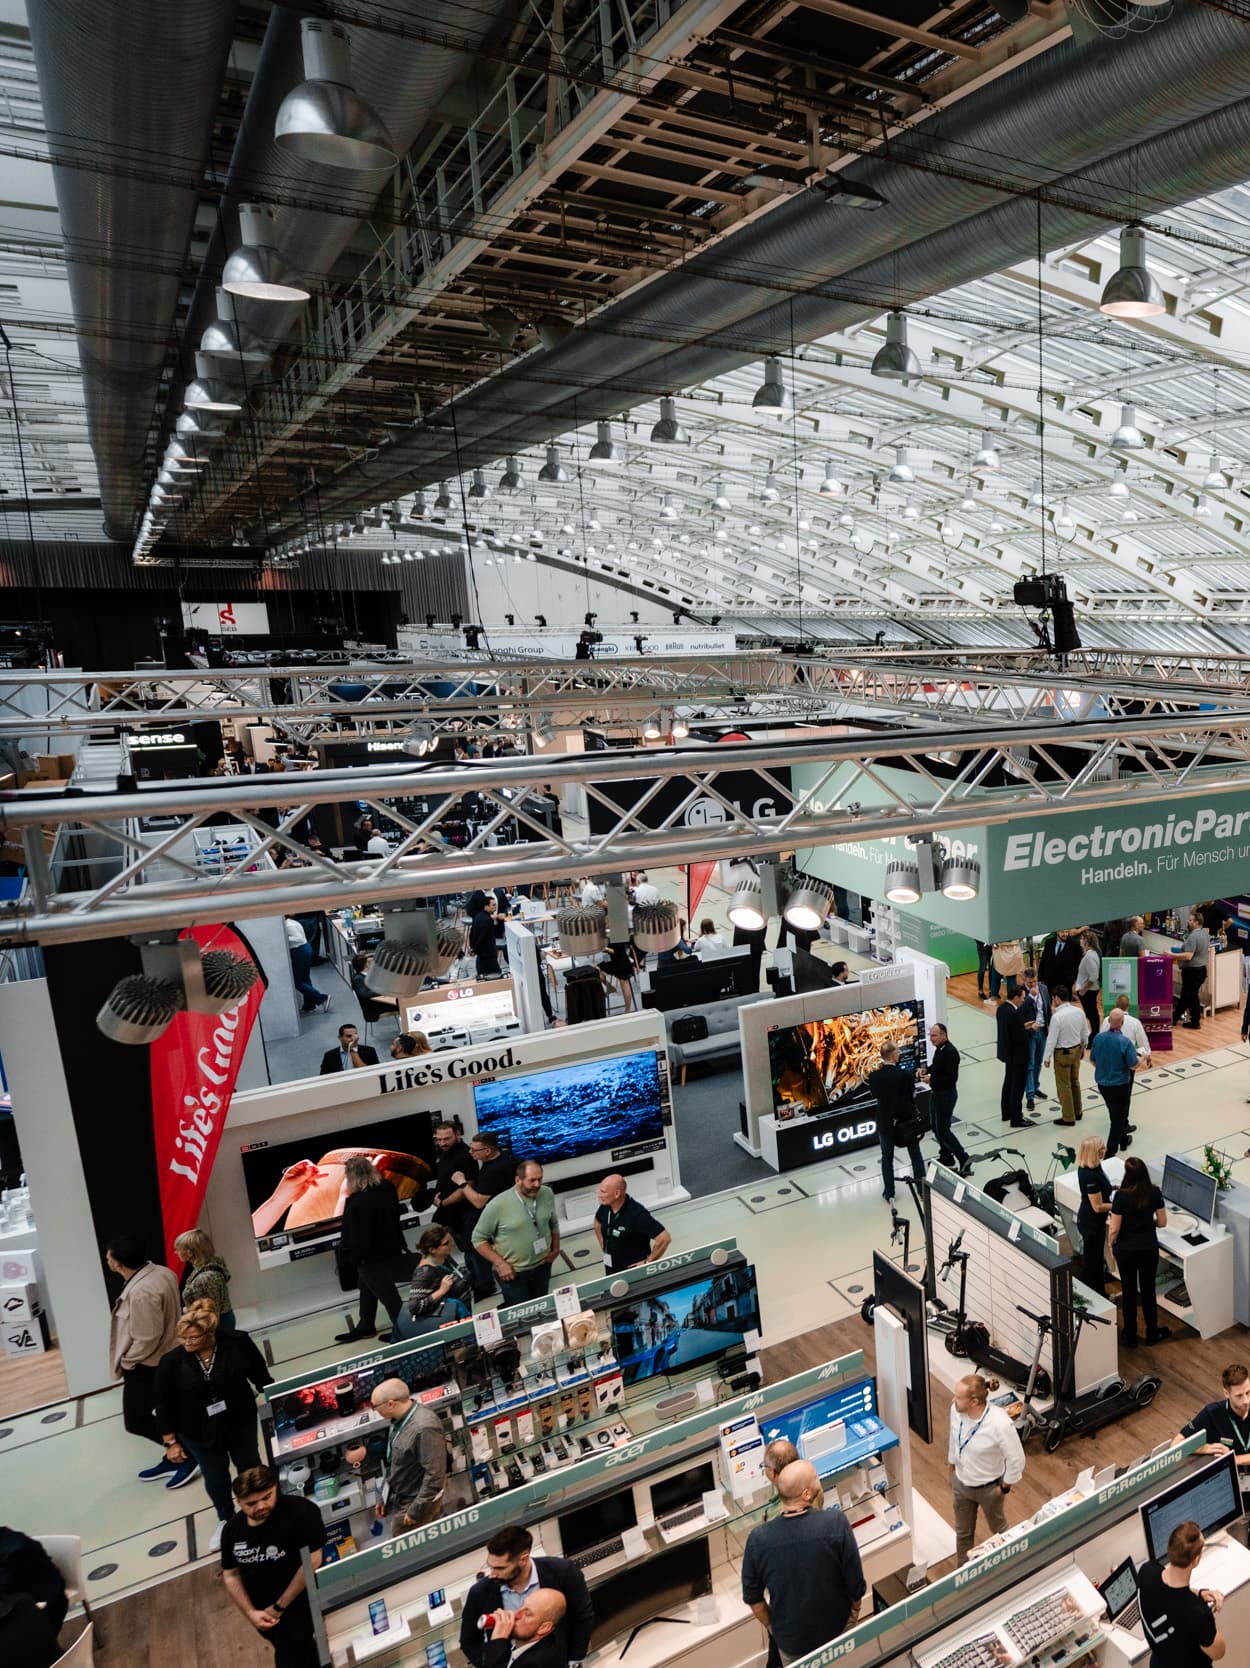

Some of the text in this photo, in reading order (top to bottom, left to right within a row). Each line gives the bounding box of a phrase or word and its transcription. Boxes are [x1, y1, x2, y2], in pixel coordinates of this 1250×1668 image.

[518, 646, 544, 654] Group
[690, 642, 725, 650] nutribullet
[1081, 861, 1153, 885] Handeln.
[1157, 854, 1179, 872] Für
[1183, 846, 1234, 868] Mensch
[460, 988, 474, 997] LG
[379, 1048, 522, 1094] Life's Good.
[169, 1086, 222, 1186] Life's
[813, 1121, 877, 1150] LG OLED
[646, 1252, 696, 1275] SONY
[507, 1299, 549, 1322] hama
[335, 1354, 385, 1376] hama
[605, 1438, 650, 1467] acer
[381, 1509, 481, 1559] SAMSUNG
[955, 1537, 1029, 1588] Marketing
